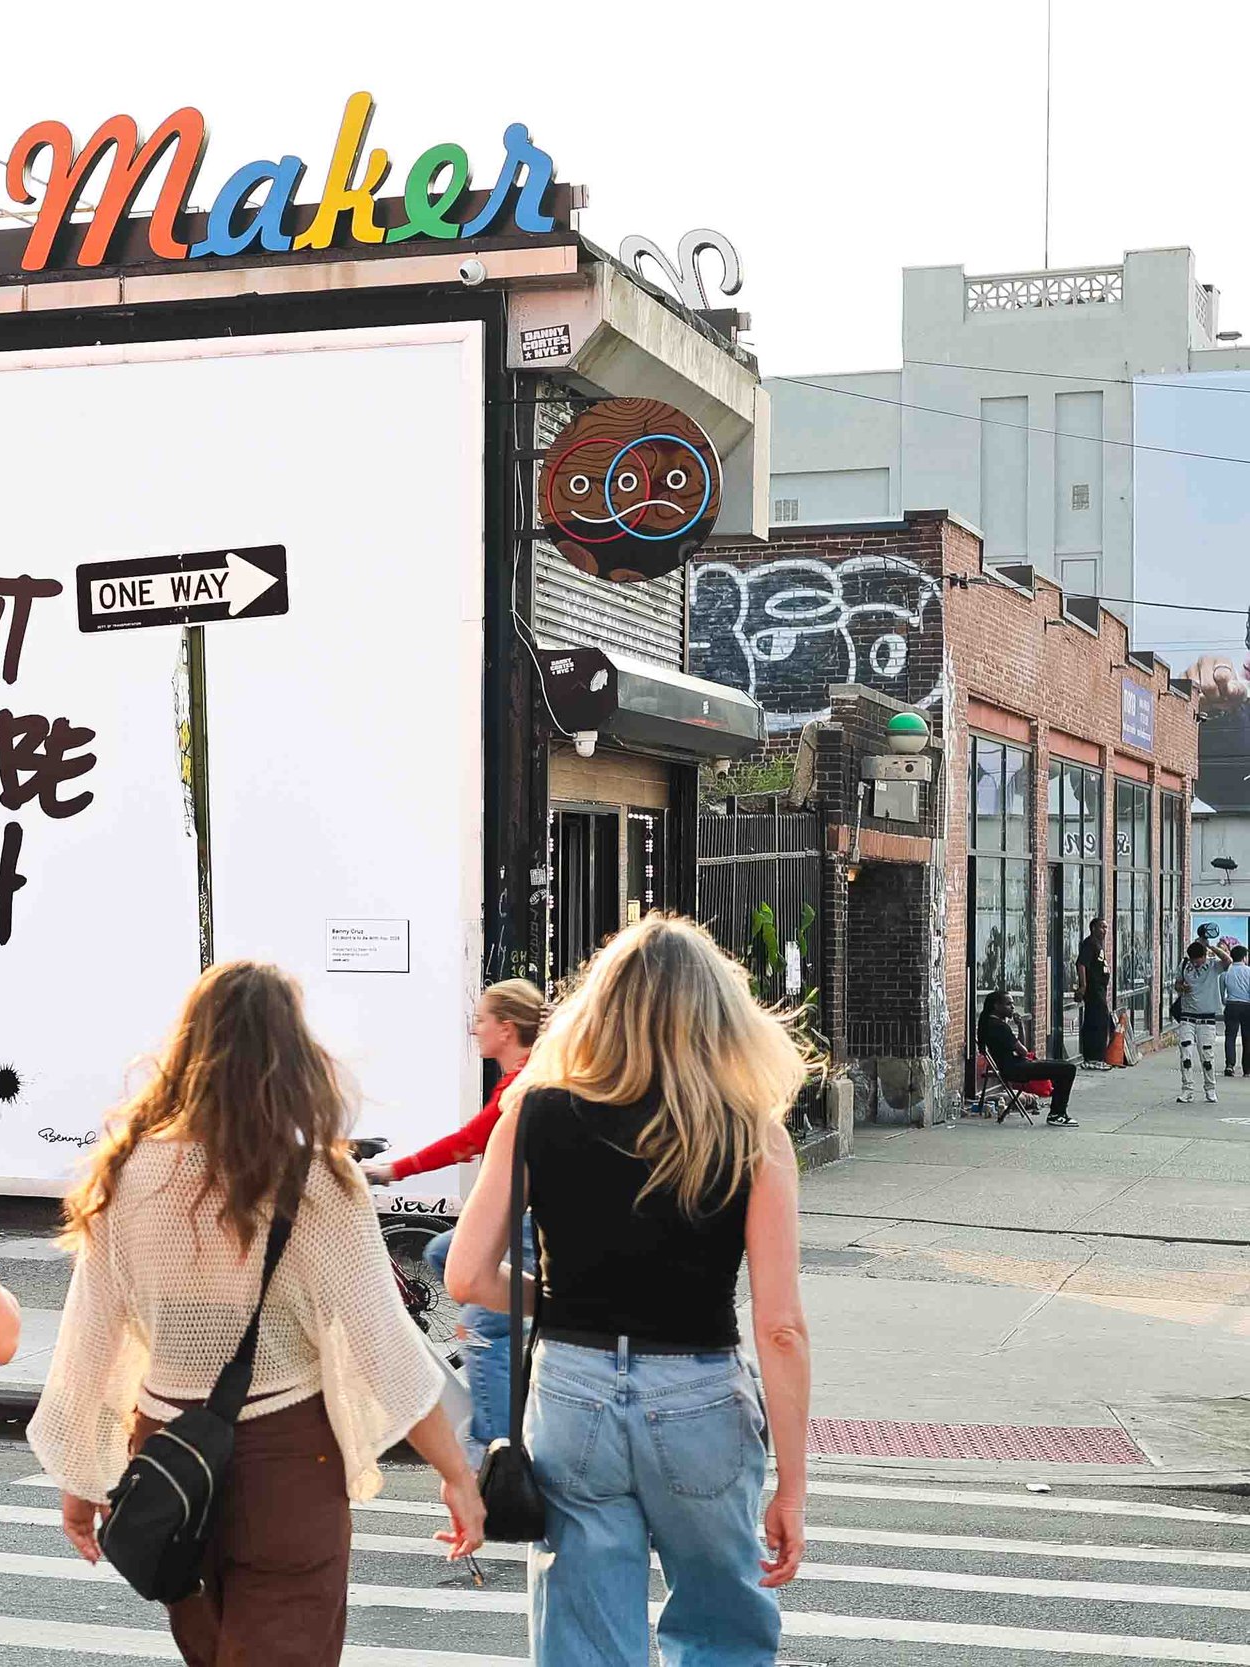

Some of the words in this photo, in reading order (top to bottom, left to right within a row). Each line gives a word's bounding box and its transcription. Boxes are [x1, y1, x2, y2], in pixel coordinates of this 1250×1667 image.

[6, 92, 555, 270] Maker
[525, 327, 565, 341] DANNY
[523, 335, 569, 351] CORTES
[534, 347, 559, 358] NYC
[100, 579, 155, 610] ONE
[170, 571, 230, 603] WAY
[1192, 895, 1235, 911] seen
